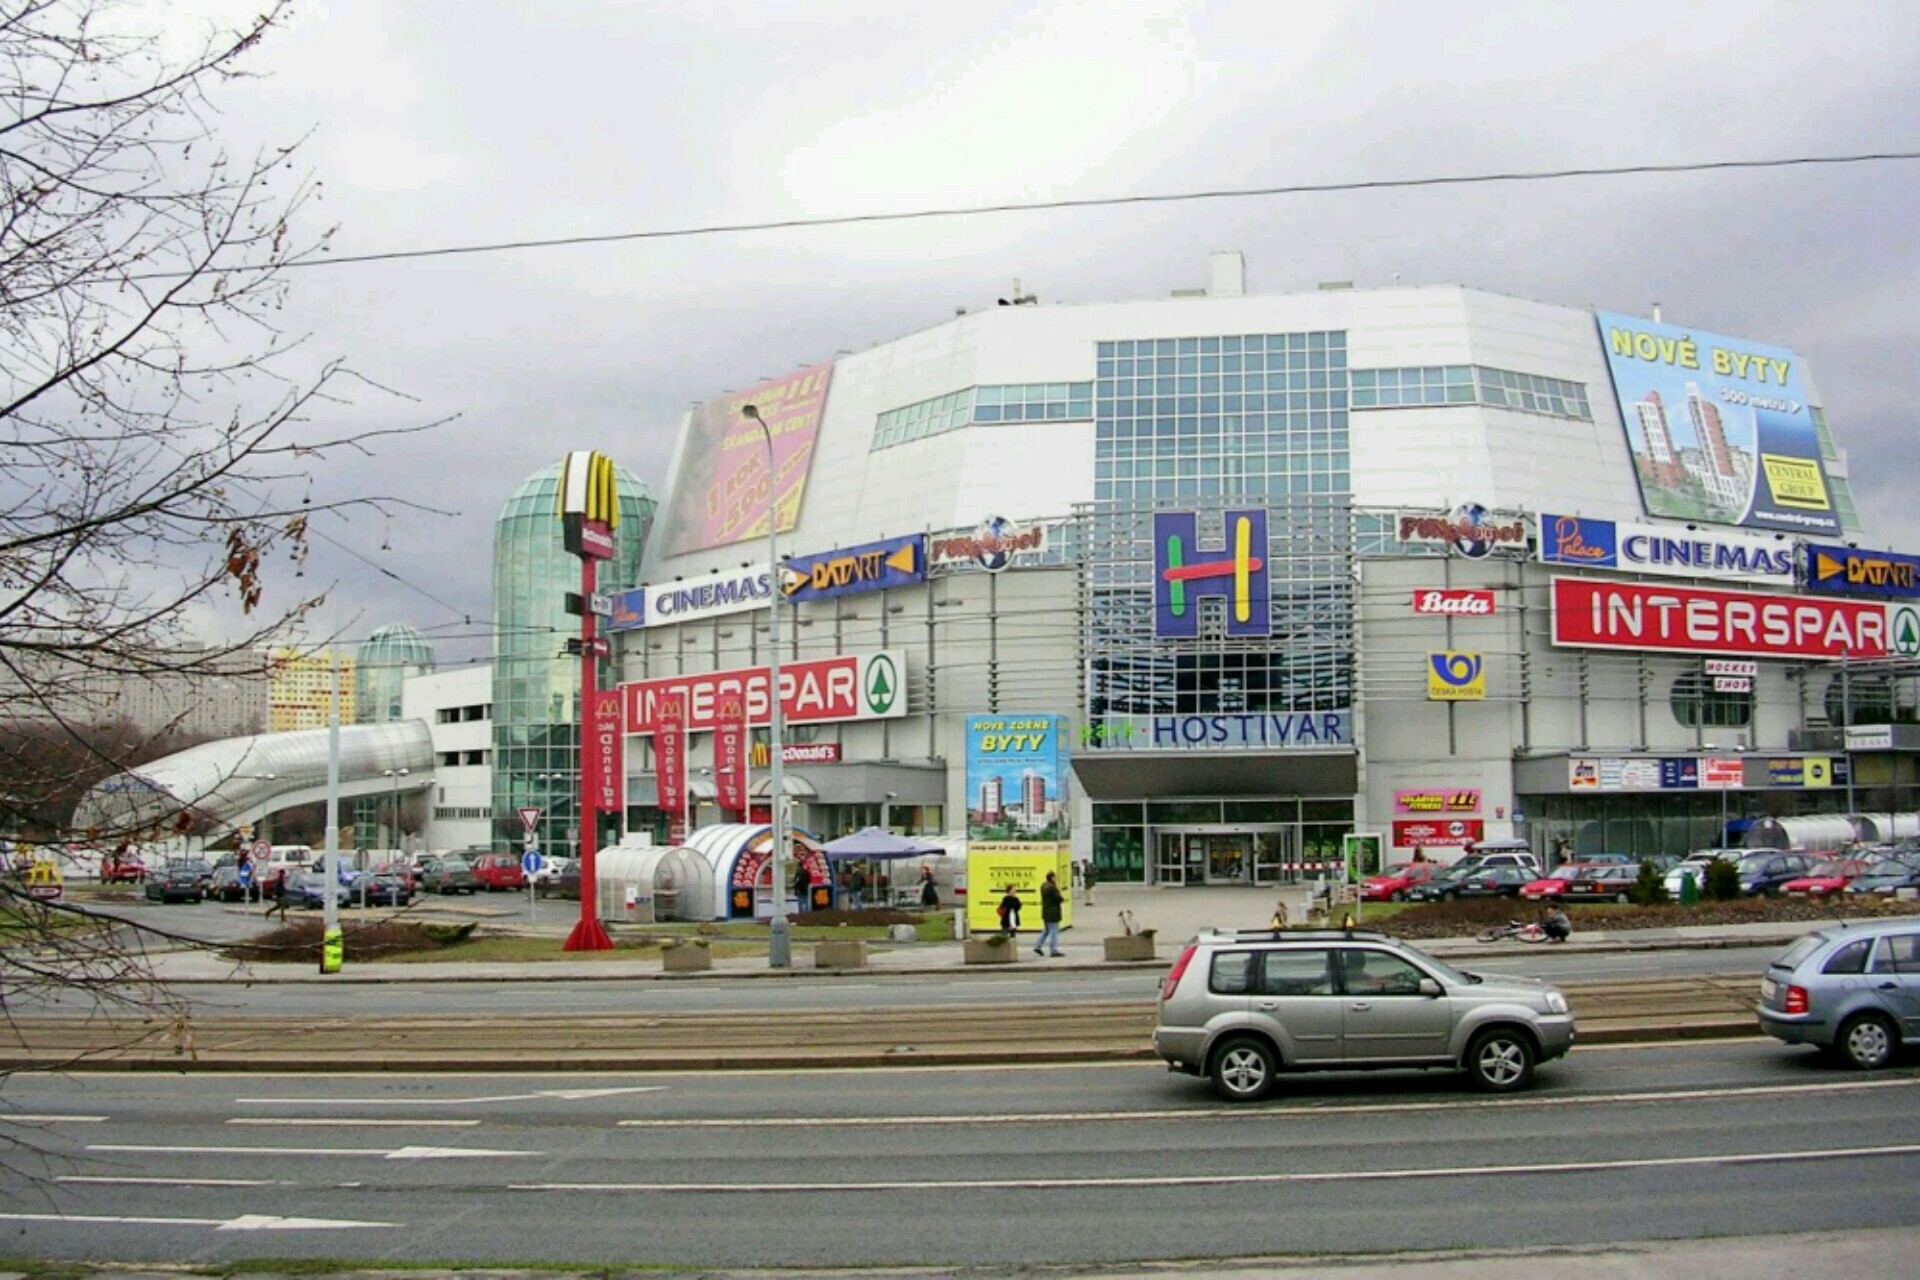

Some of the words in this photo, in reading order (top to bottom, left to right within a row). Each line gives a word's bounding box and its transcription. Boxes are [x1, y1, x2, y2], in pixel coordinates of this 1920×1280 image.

[1611, 327, 1699, 370] NOVÉ
[1712, 348, 1790, 386] BYTY
[811, 552, 886, 590] DATART
[1622, 535, 1792, 575] CINEMAS
[1847, 556, 1918, 589] DATART
[656, 574, 771, 615] CINEMAS
[1591, 591, 1884, 650] INTERSPAR
[1707, 662, 1755, 673] HOCKEY
[1716, 680, 1748, 690] SHOP
[782, 746, 834, 760] cDonald's
[981, 734, 1045, 752] BYTY
